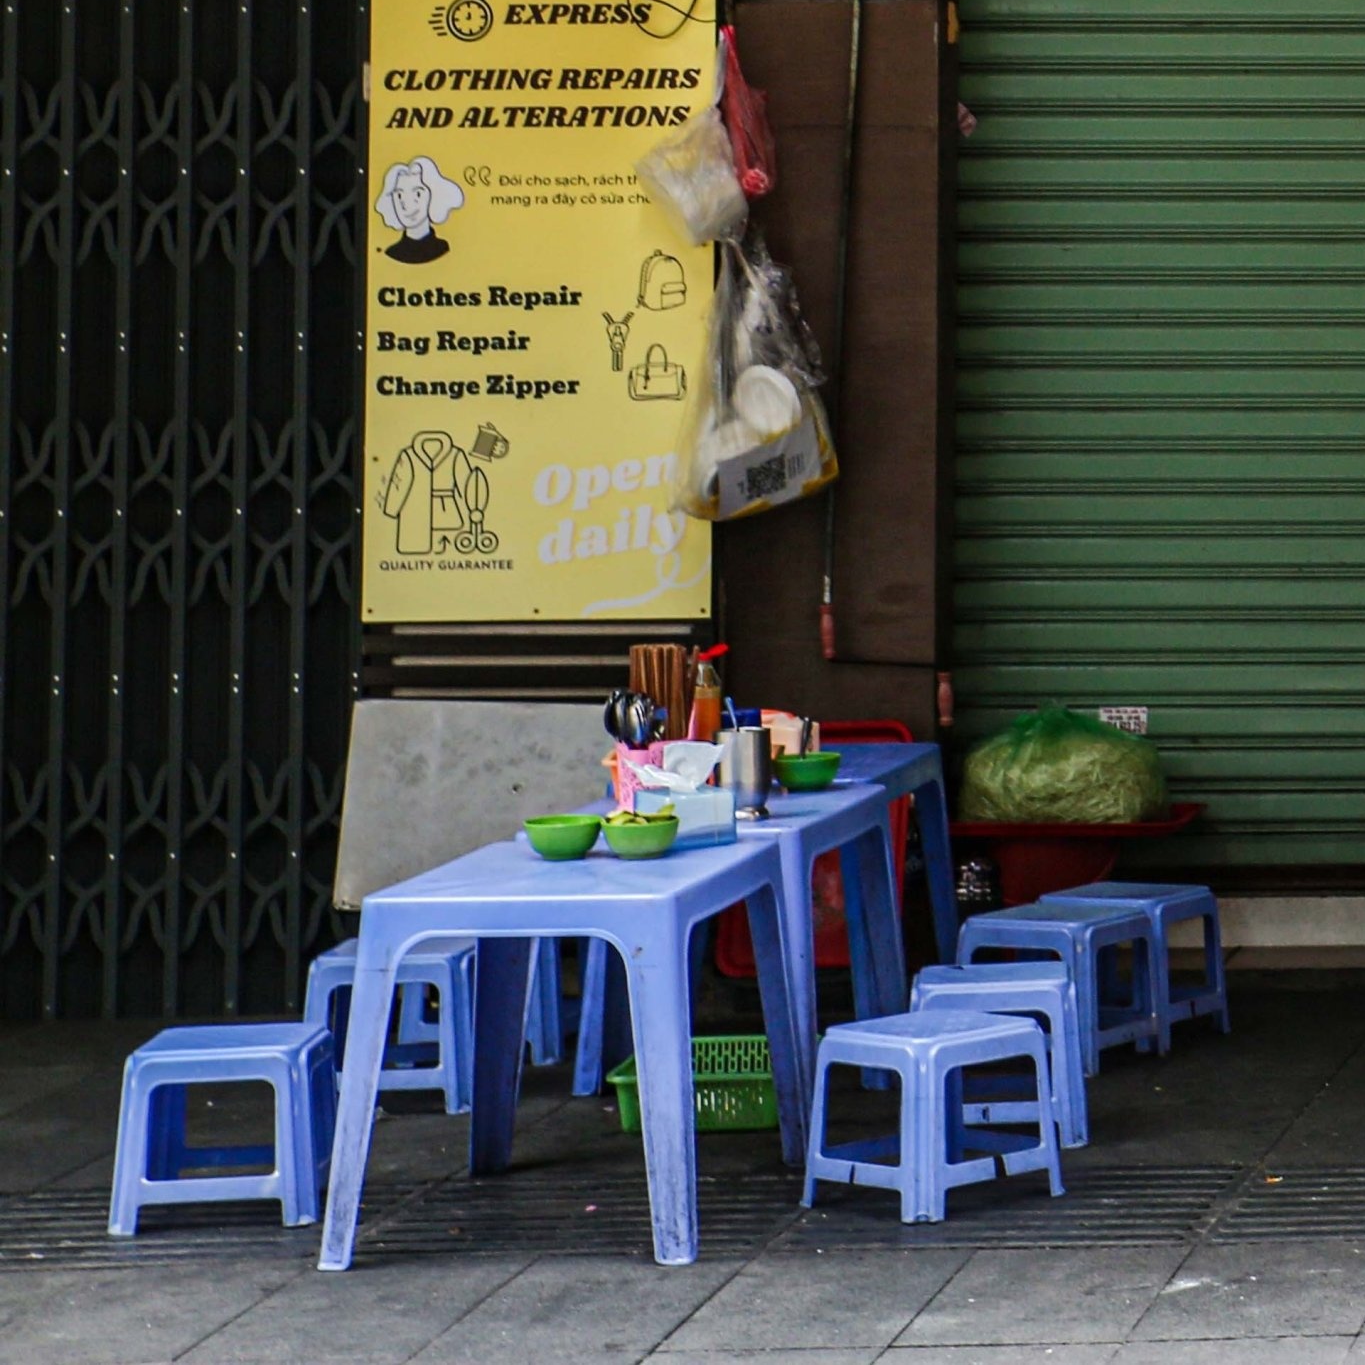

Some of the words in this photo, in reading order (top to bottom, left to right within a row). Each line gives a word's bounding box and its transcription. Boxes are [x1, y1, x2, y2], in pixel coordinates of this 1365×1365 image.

[504, 3, 653, 26] EXPRESS
[384, 68, 553, 92] CLOTHING
[560, 67, 702, 90] REPAIRS
[385, 106, 454, 129] AND
[458, 105, 691, 128] ALTERATIONS
[525, 174, 551, 186] cho
[490, 194, 532, 207] mang
[535, 195, 549, 206] ra
[377, 286, 482, 307] Clothes
[488, 285, 582, 310] Repair
[376, 331, 432, 355] Bag
[436, 331, 530, 355] Repair
[376, 375, 481, 402] Change
[486, 374, 581, 402] Zipper
[532, 452, 678, 511] Open
[536, 505, 688, 566] daily
[379, 559, 433, 572] QUALITY
[438, 559, 514, 571] GUARANTEE
